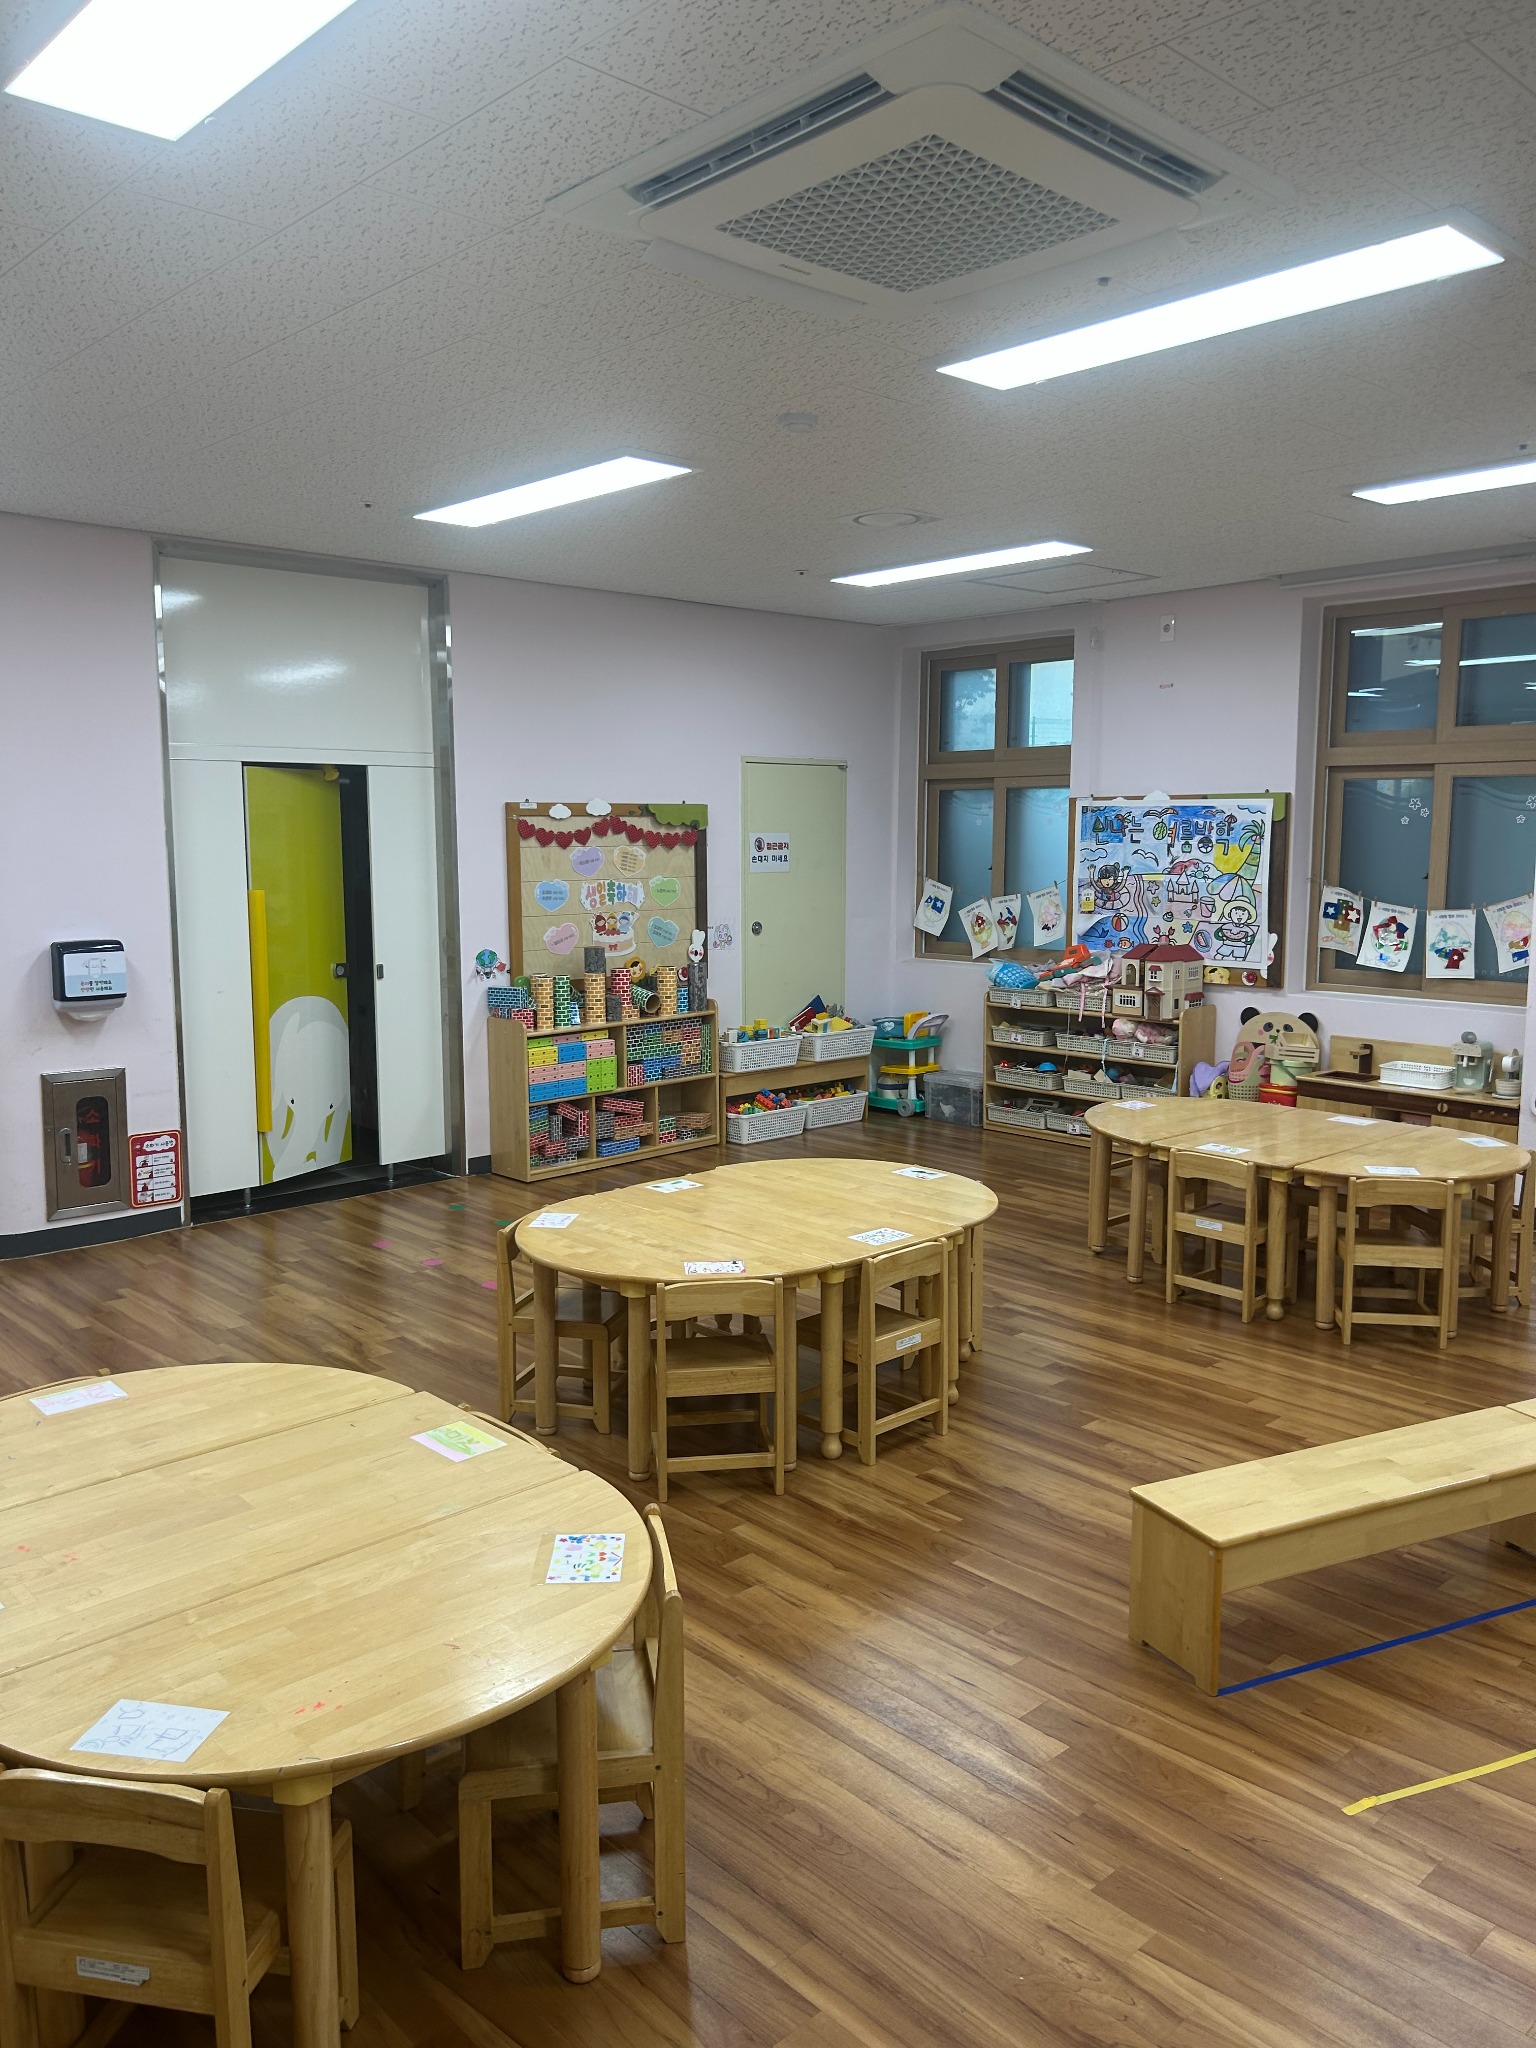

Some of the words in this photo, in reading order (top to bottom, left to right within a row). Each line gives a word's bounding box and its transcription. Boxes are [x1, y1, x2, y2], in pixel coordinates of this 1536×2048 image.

[1092, 813, 1144, 846] 신나는
[1152, 813, 1237, 856] 여름방학
[751, 855, 769, 863] 손대지
